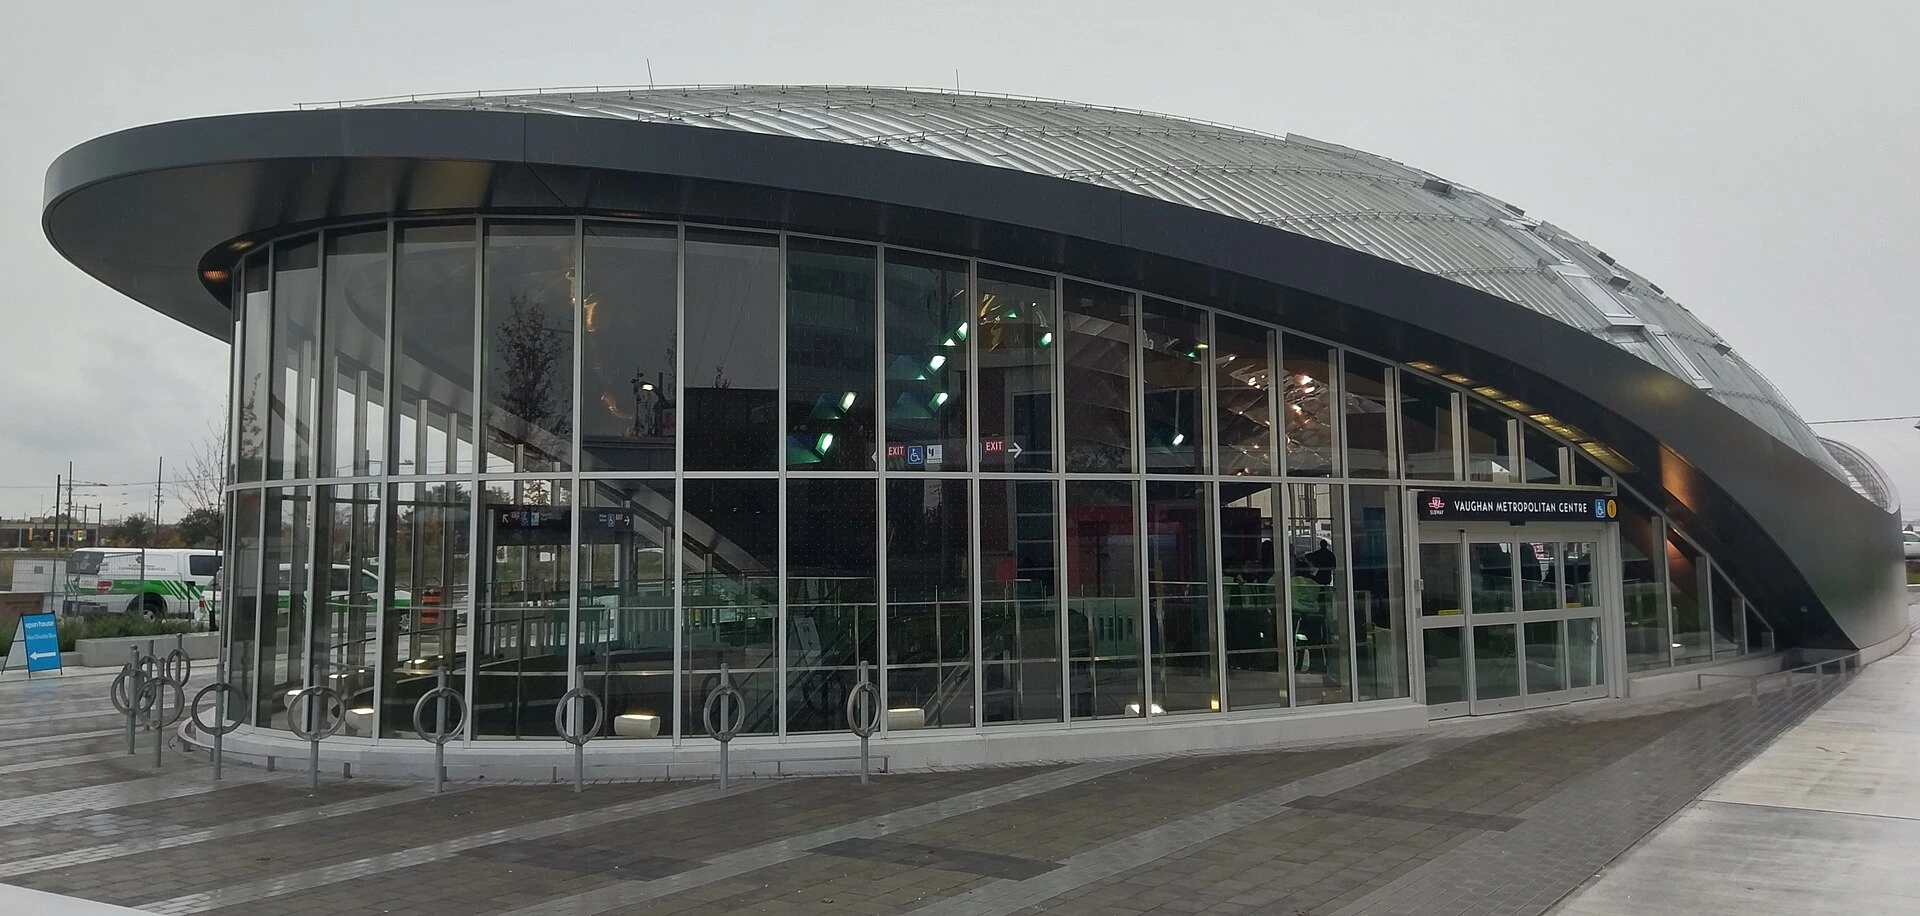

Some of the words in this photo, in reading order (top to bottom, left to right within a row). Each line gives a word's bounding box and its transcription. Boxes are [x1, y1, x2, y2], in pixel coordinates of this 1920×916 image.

[888, 446, 904, 456] EXIT
[986, 441, 1003, 451] EXIT
[1454, 500, 1494, 512] VAUGHAN
[1496, 501, 1556, 513] METROPOLITAN
[1558, 502, 1588, 513] CENTRE
